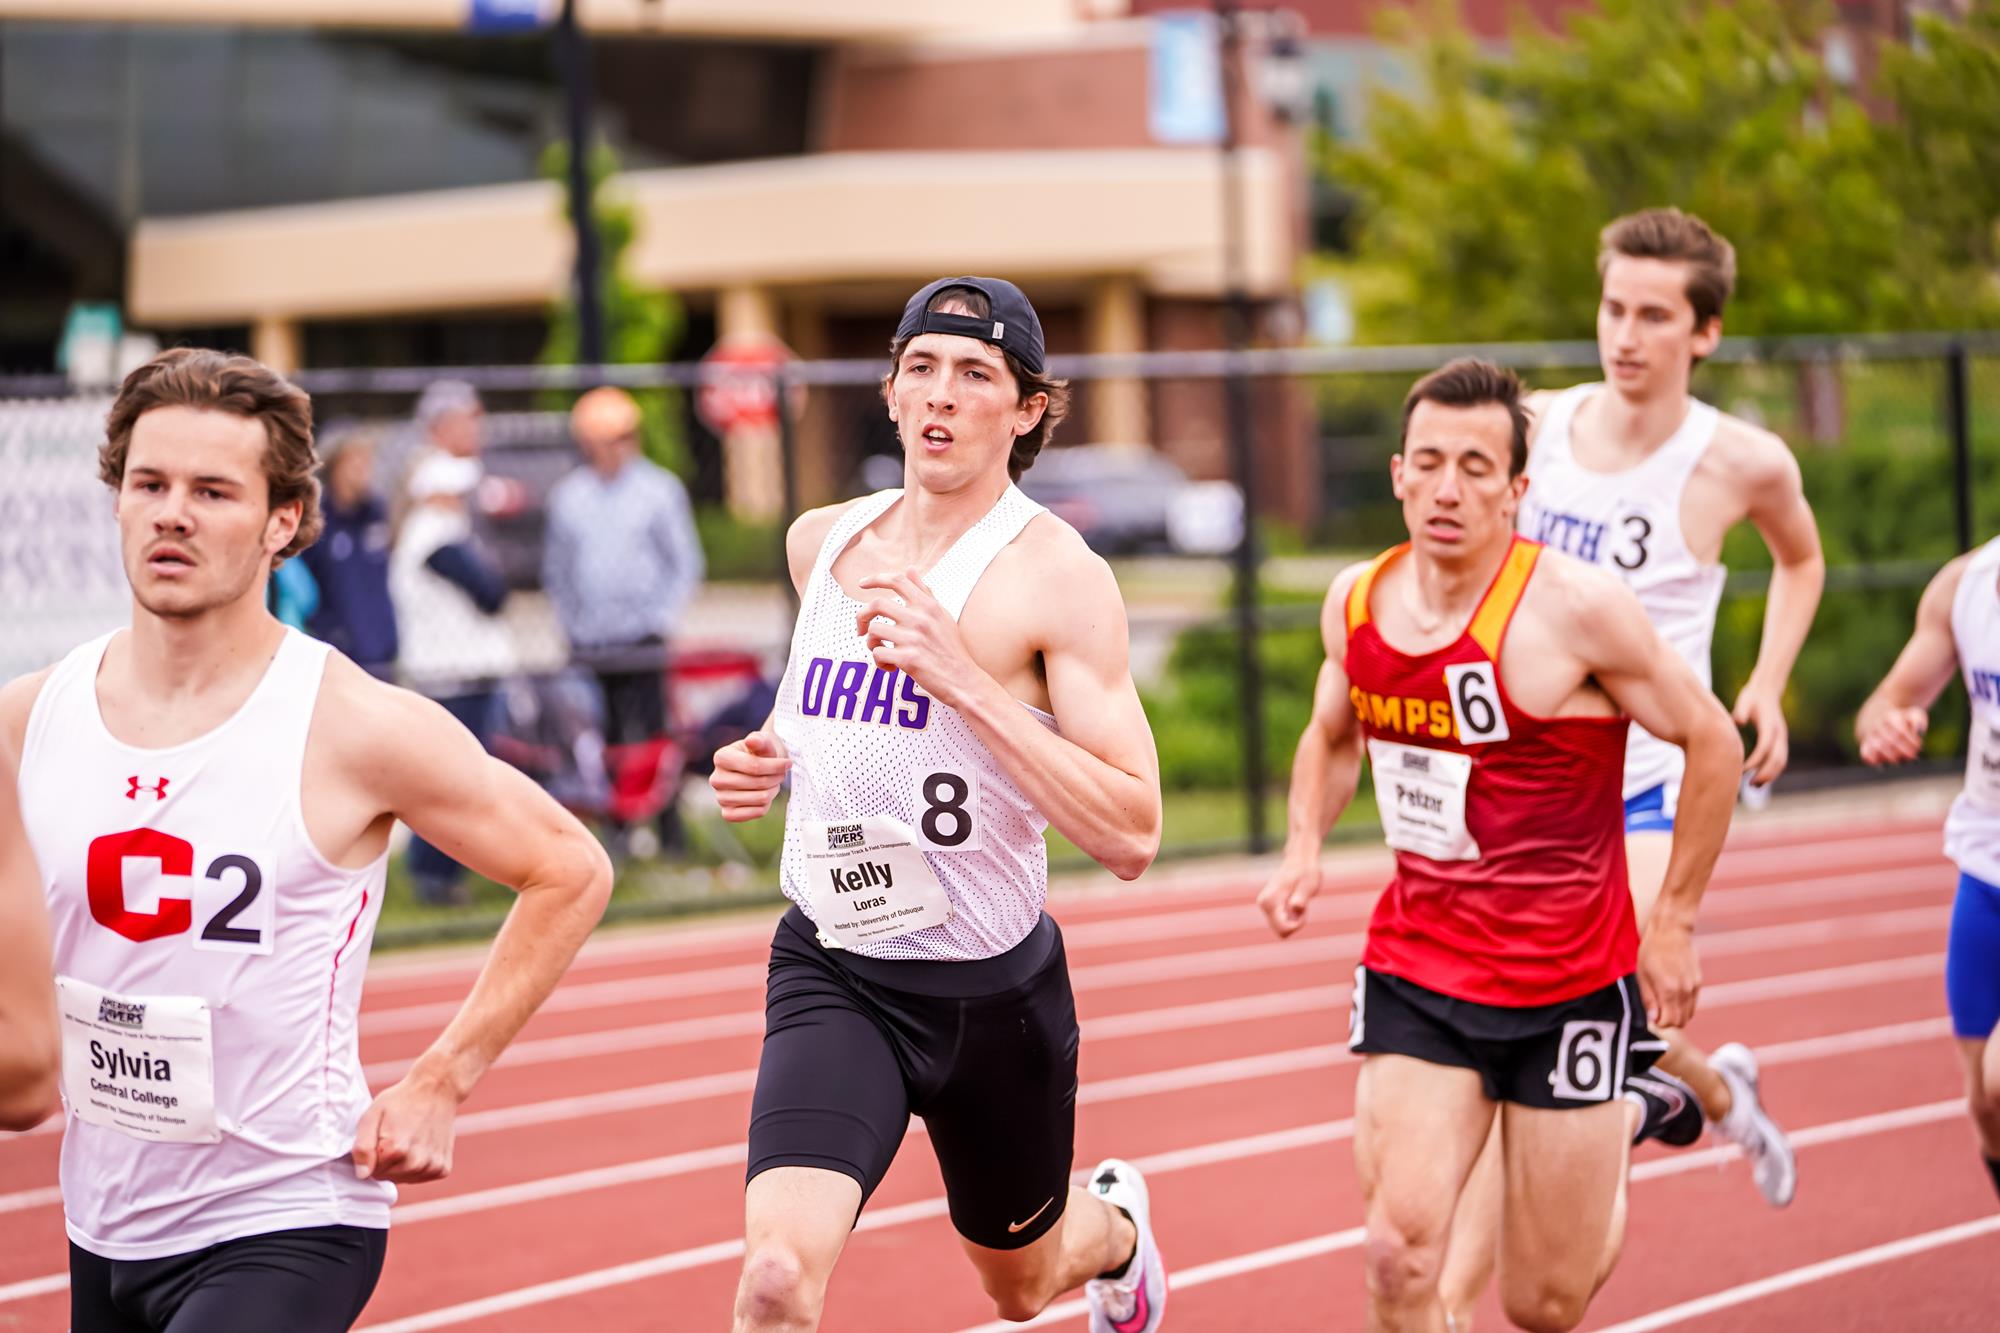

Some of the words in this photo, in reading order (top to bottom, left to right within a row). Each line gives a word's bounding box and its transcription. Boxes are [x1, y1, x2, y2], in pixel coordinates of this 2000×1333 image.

[1613, 516, 1652, 570] 3
[801, 656, 932, 731] ORAS
[1350, 686, 1461, 741] SIMPS
[1458, 671, 1496, 735] 6
[828, 824, 862, 834] AMERICAN
[921, 772, 972, 847] 8
[87, 827, 194, 943] C
[200, 853, 263, 944] 2
[830, 861, 893, 894] Kelly
[853, 896, 887, 911] Loras
[834, 922, 851, 930] Hosted
[860, 914, 890, 926] University
[890, 911, 897, 919] of
[897, 905, 925, 917] Dubuque
[90, 1039, 171, 1082] Sylvia
[1566, 1028, 1603, 1092] 6
[90, 1077, 128, 1100] Central
[131, 1088, 179, 1109] College
